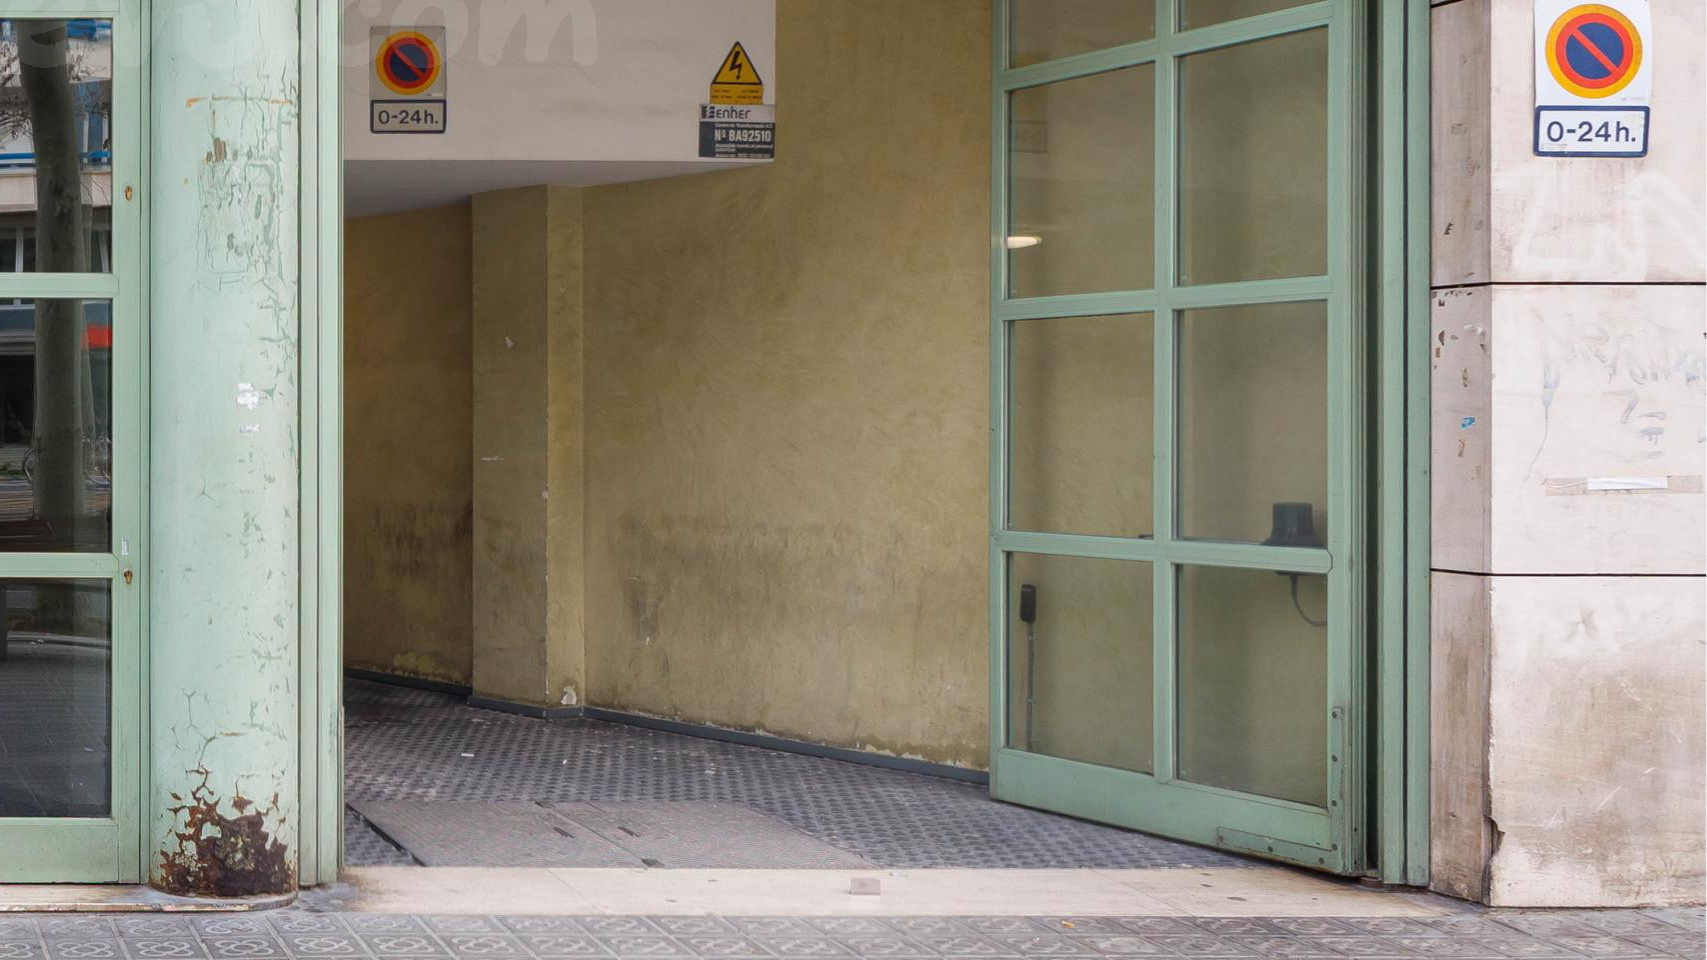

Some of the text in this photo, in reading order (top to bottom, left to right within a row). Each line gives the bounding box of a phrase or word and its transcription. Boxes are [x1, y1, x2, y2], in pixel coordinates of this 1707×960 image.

[378, 109, 439, 125] 0-24h.
[729, 129, 772, 142] BA92510
[1547, 121, 1636, 142] 0-24h.
